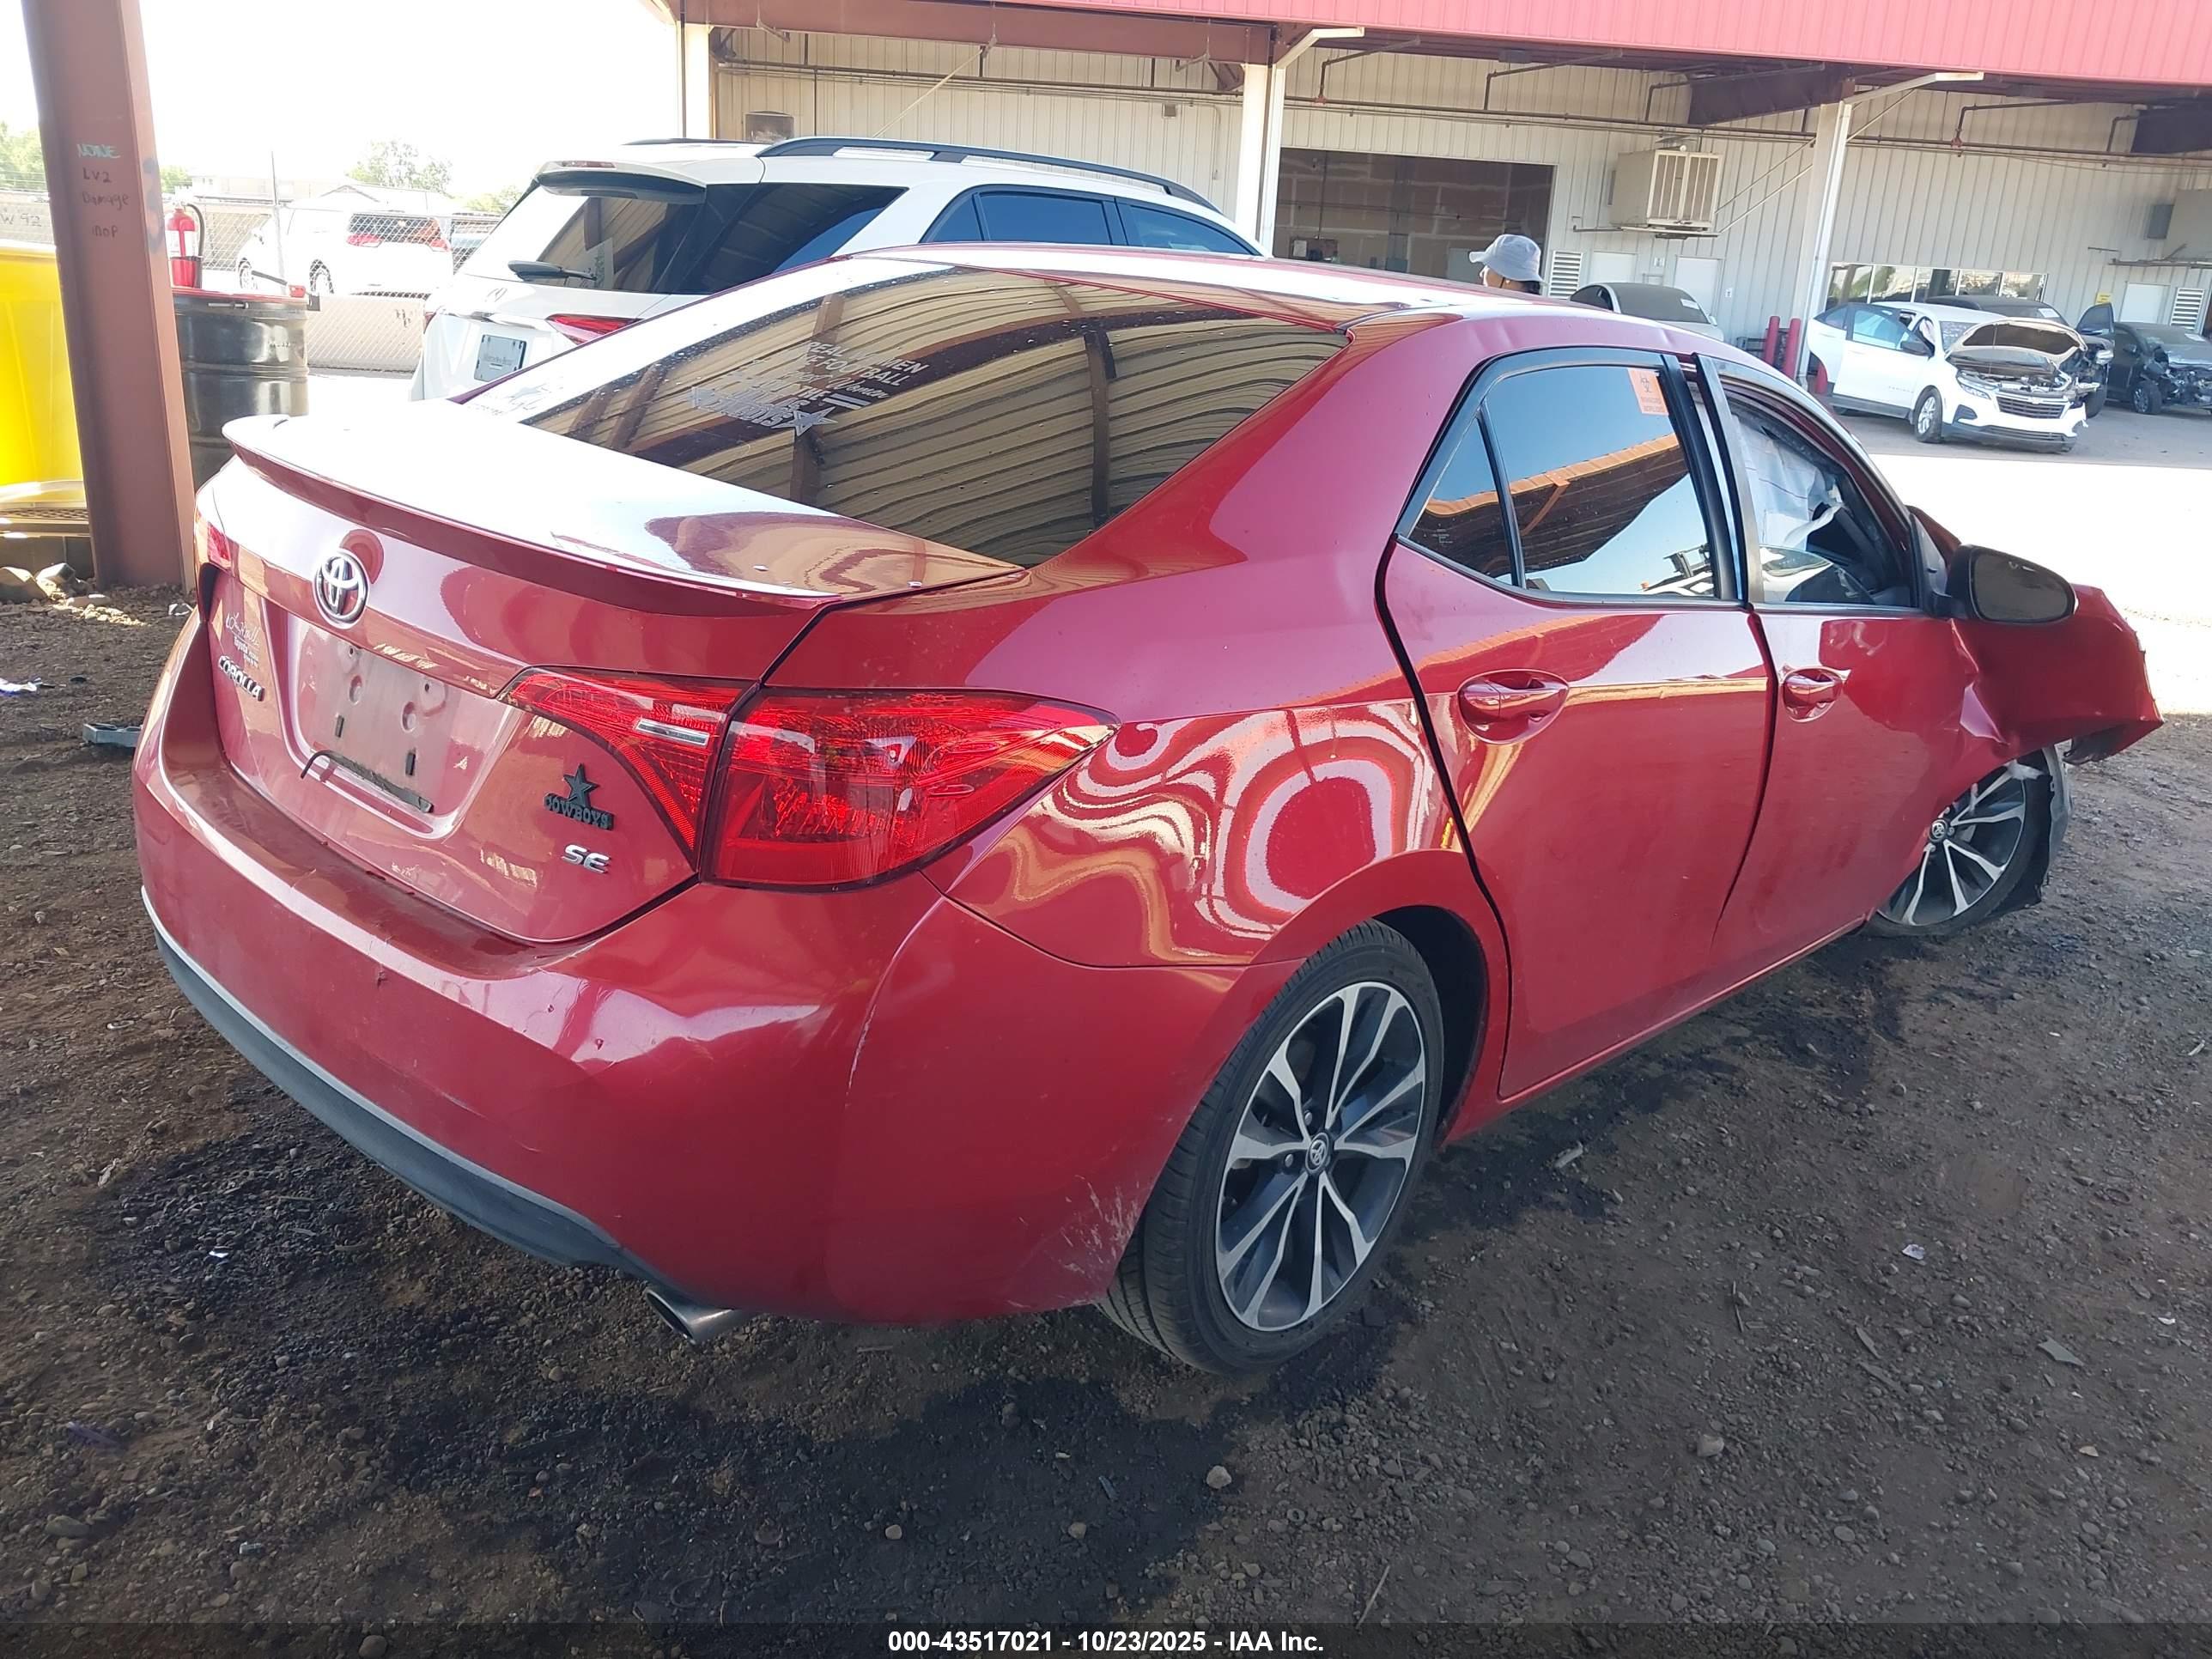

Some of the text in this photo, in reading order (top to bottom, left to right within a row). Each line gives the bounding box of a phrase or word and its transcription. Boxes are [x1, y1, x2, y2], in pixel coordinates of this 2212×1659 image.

[219, 655, 264, 701] COROLLA
[543, 793, 614, 830] COWBOYS
[561, 844, 611, 874] SE
